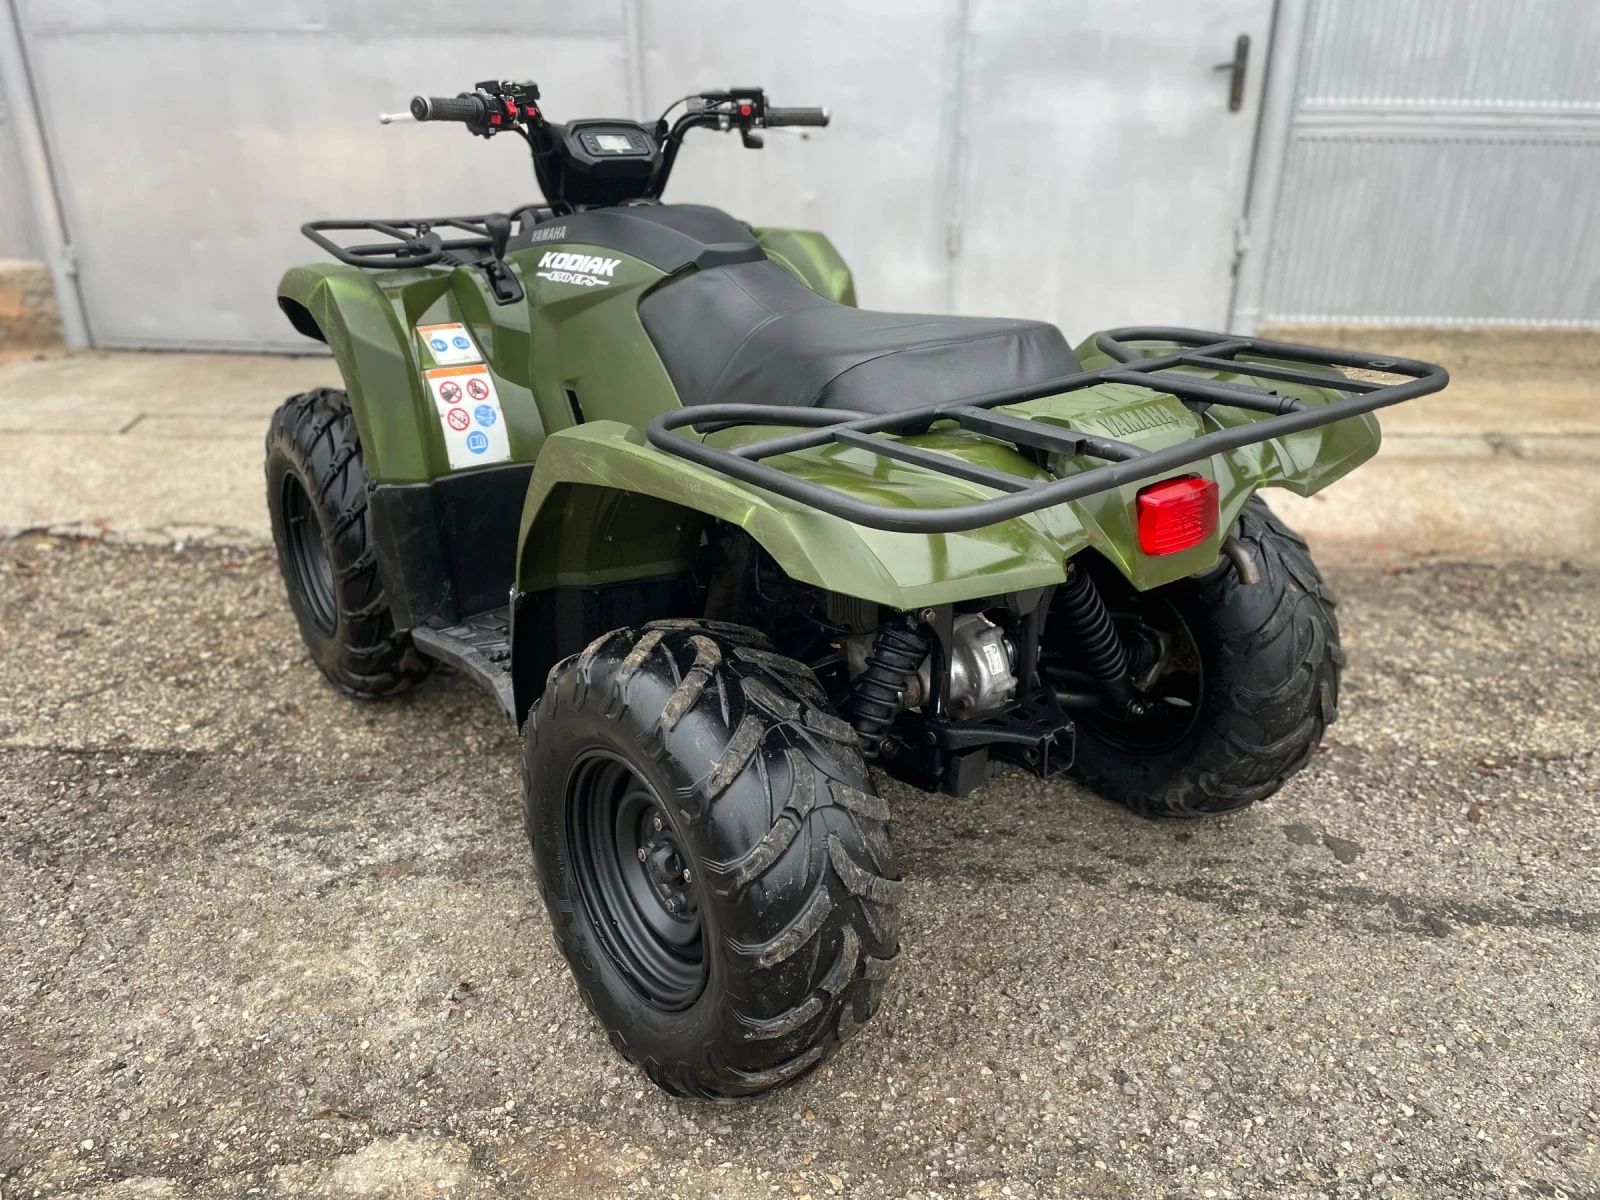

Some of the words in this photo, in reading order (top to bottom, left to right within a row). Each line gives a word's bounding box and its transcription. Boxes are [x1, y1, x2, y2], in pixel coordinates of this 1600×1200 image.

[531, 226, 567, 242] YAMAHA
[538, 252, 622, 277] KODIAK
[547, 271, 572, 282] 450
[571, 274, 597, 286] EPS
[1096, 404, 1179, 437] YAMAHA
